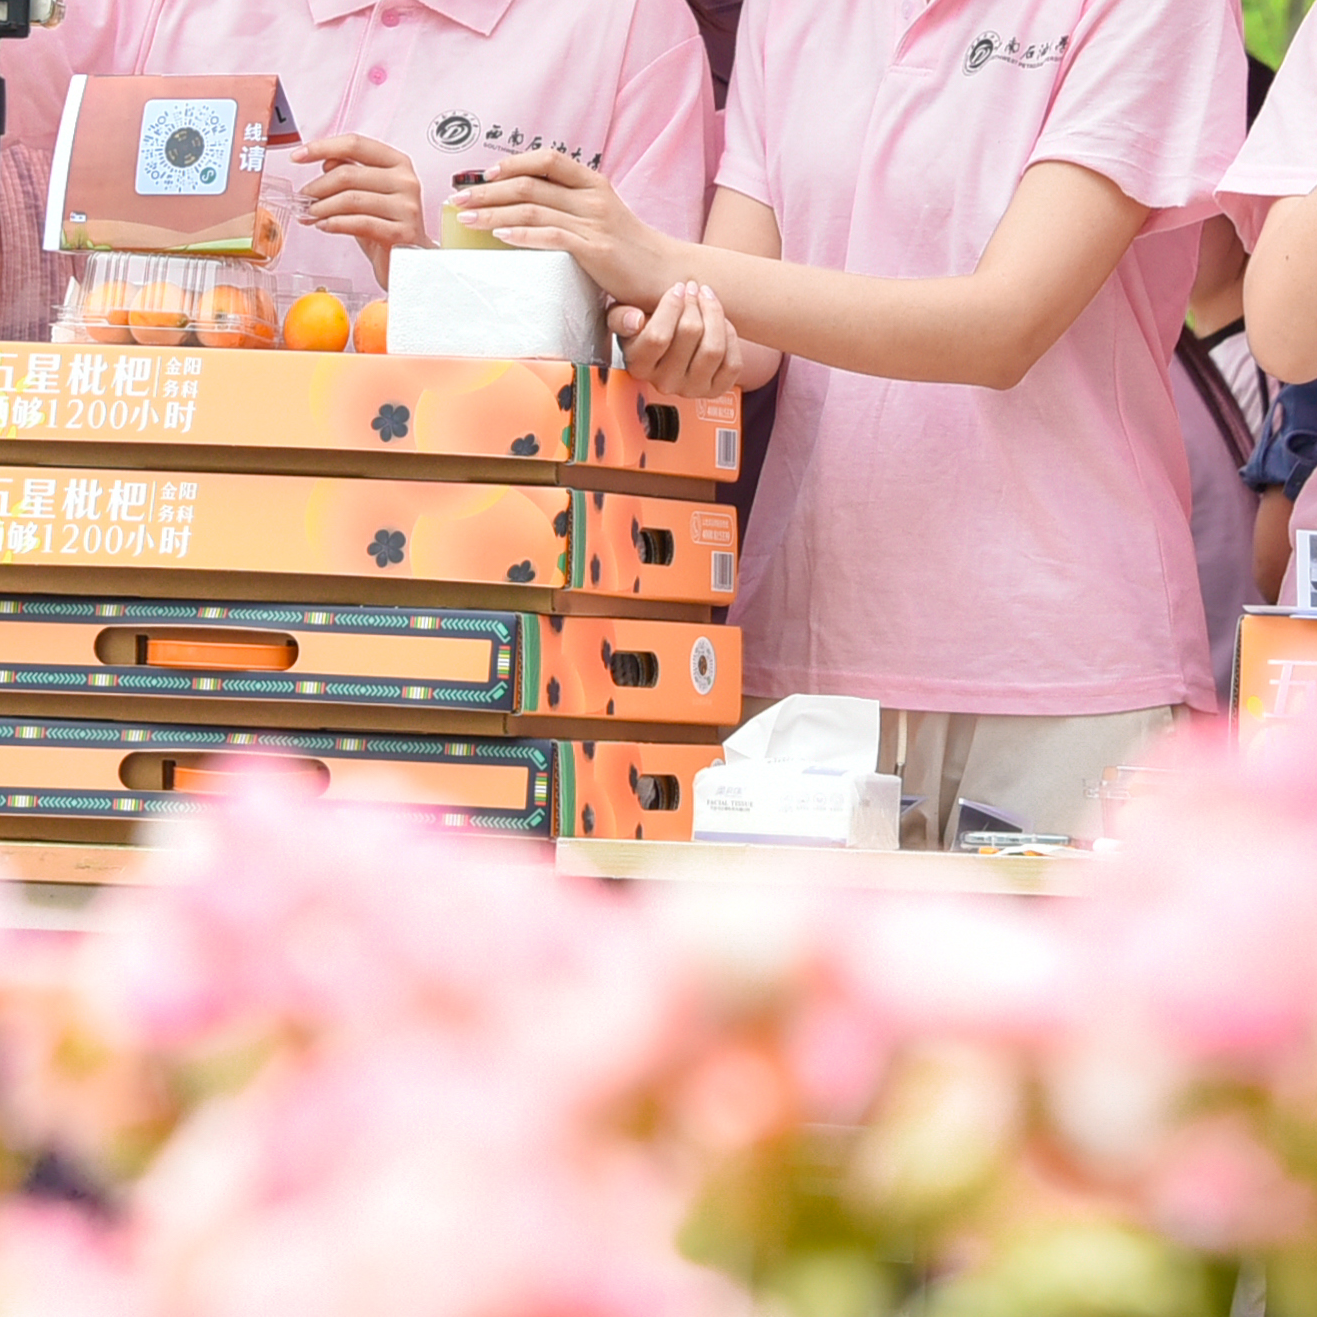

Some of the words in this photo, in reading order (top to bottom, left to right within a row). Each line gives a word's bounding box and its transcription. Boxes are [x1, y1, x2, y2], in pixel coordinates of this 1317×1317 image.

[164, 356, 203, 376] 金阳
[162, 379, 200, 399] 务科
[160, 481, 199, 501] 金阳
[157, 504, 195, 524] 务科
